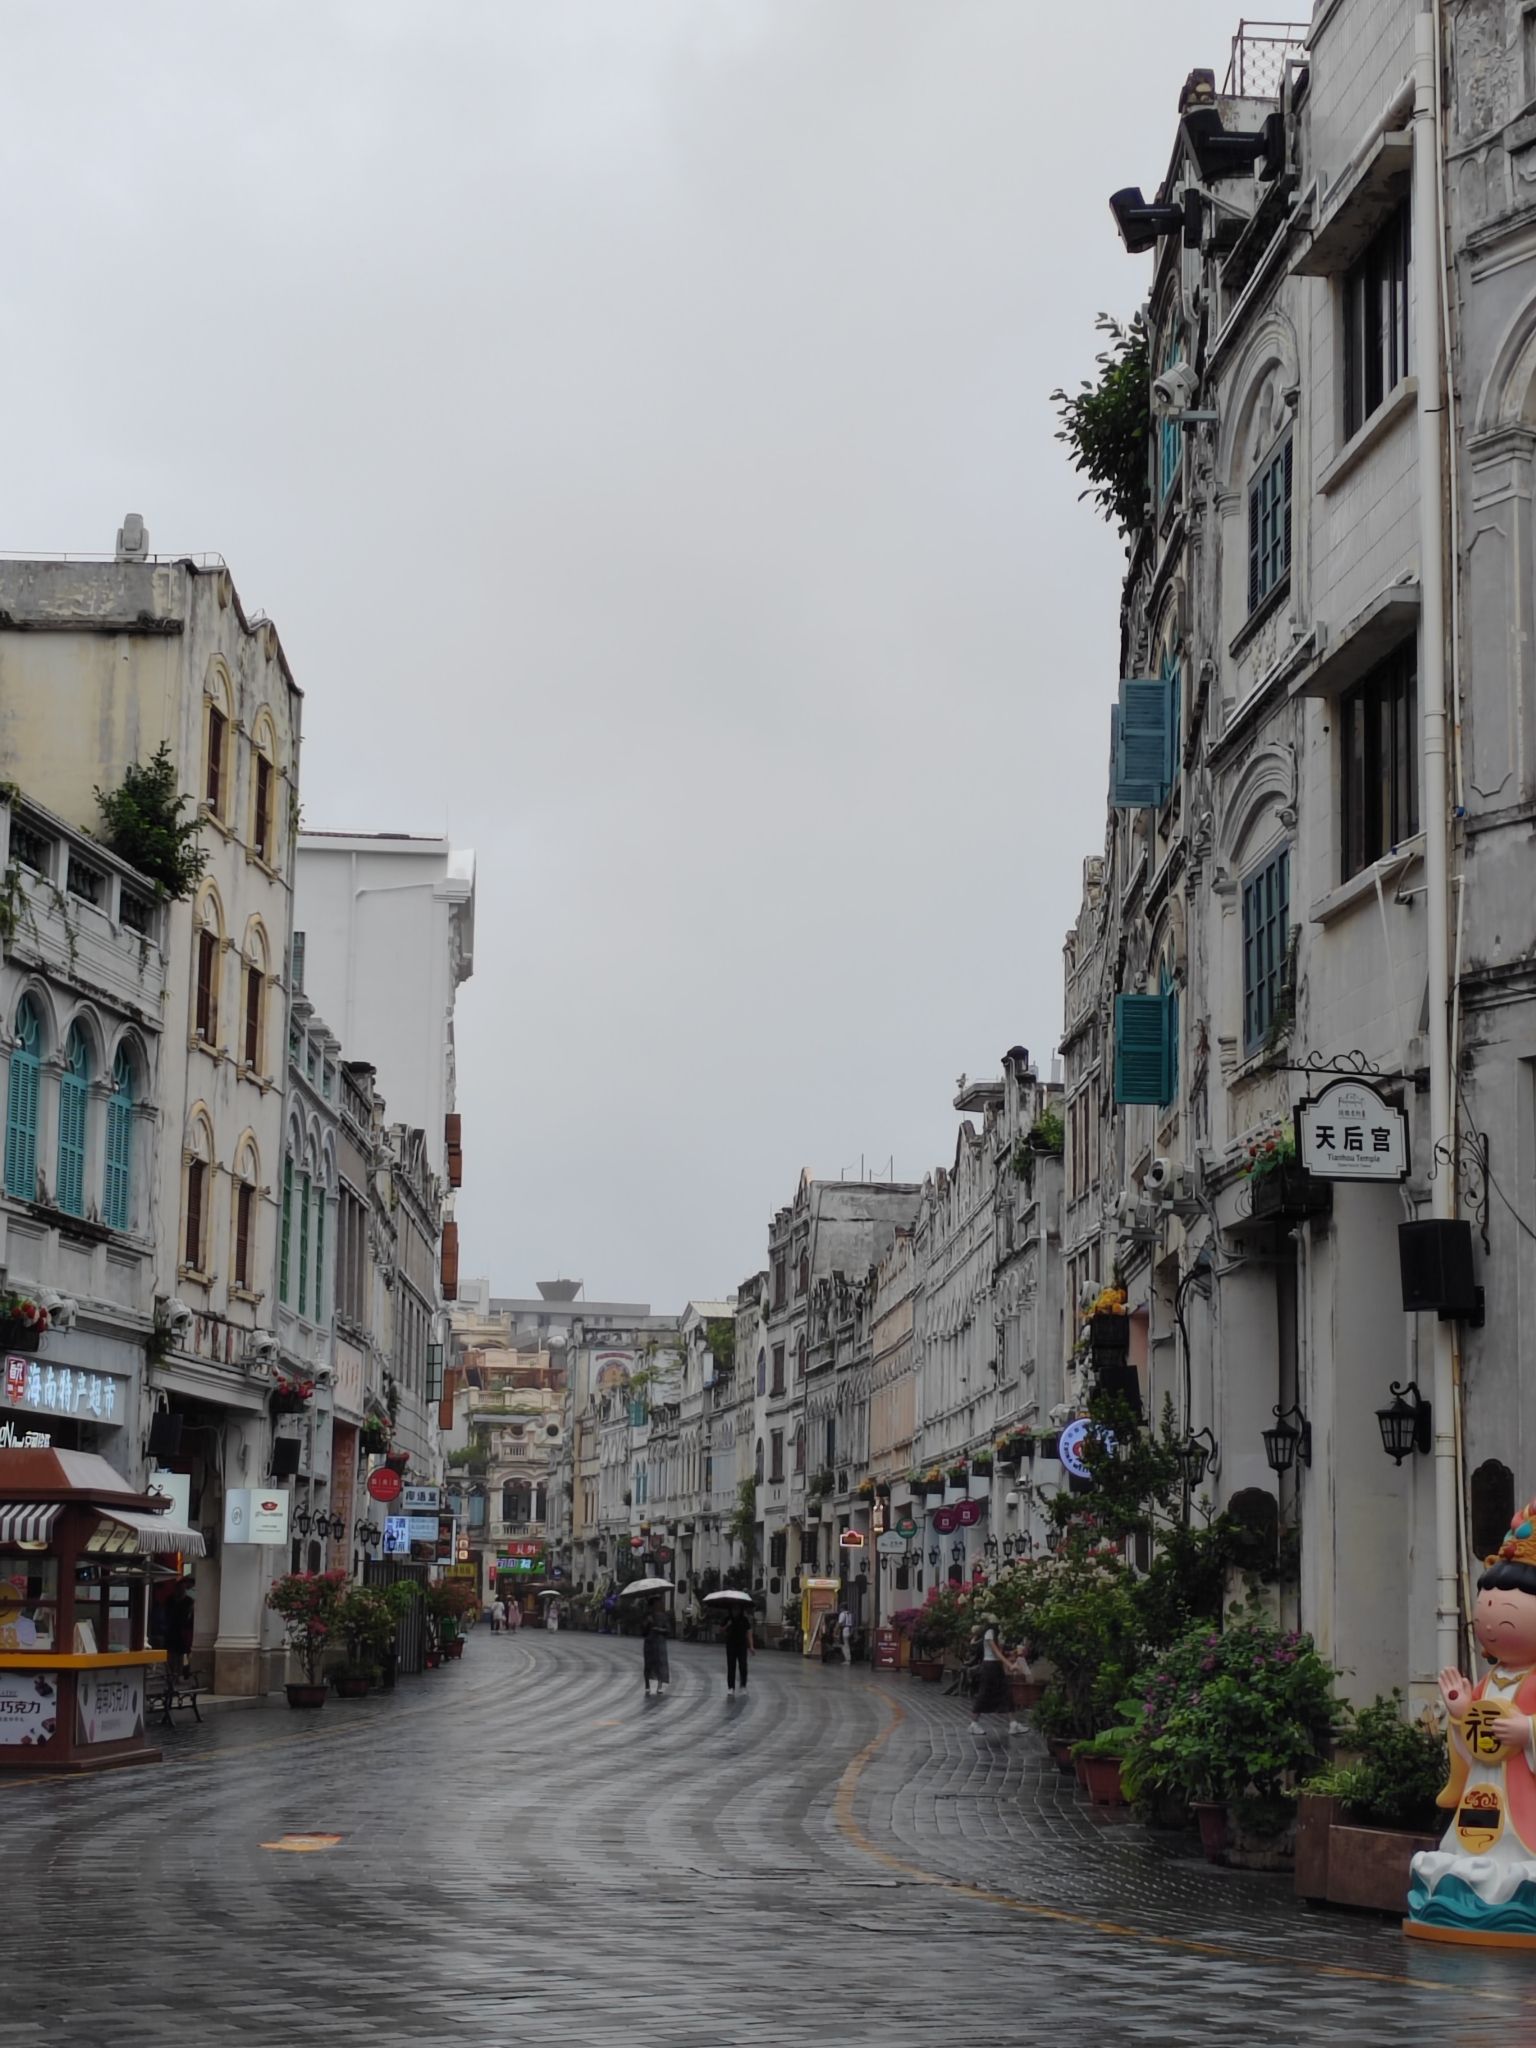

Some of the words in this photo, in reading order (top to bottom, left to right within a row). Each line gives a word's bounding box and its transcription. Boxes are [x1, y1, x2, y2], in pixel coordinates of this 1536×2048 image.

[1315, 1125, 1391, 1152] 天后宫
[1328, 1153, 1355, 1161] Tianhou
[1356, 1155, 1380, 1163] Temple
[27, 1361, 116, 1419] 海南特产超市
[1464, 1708, 1501, 1754] 福
